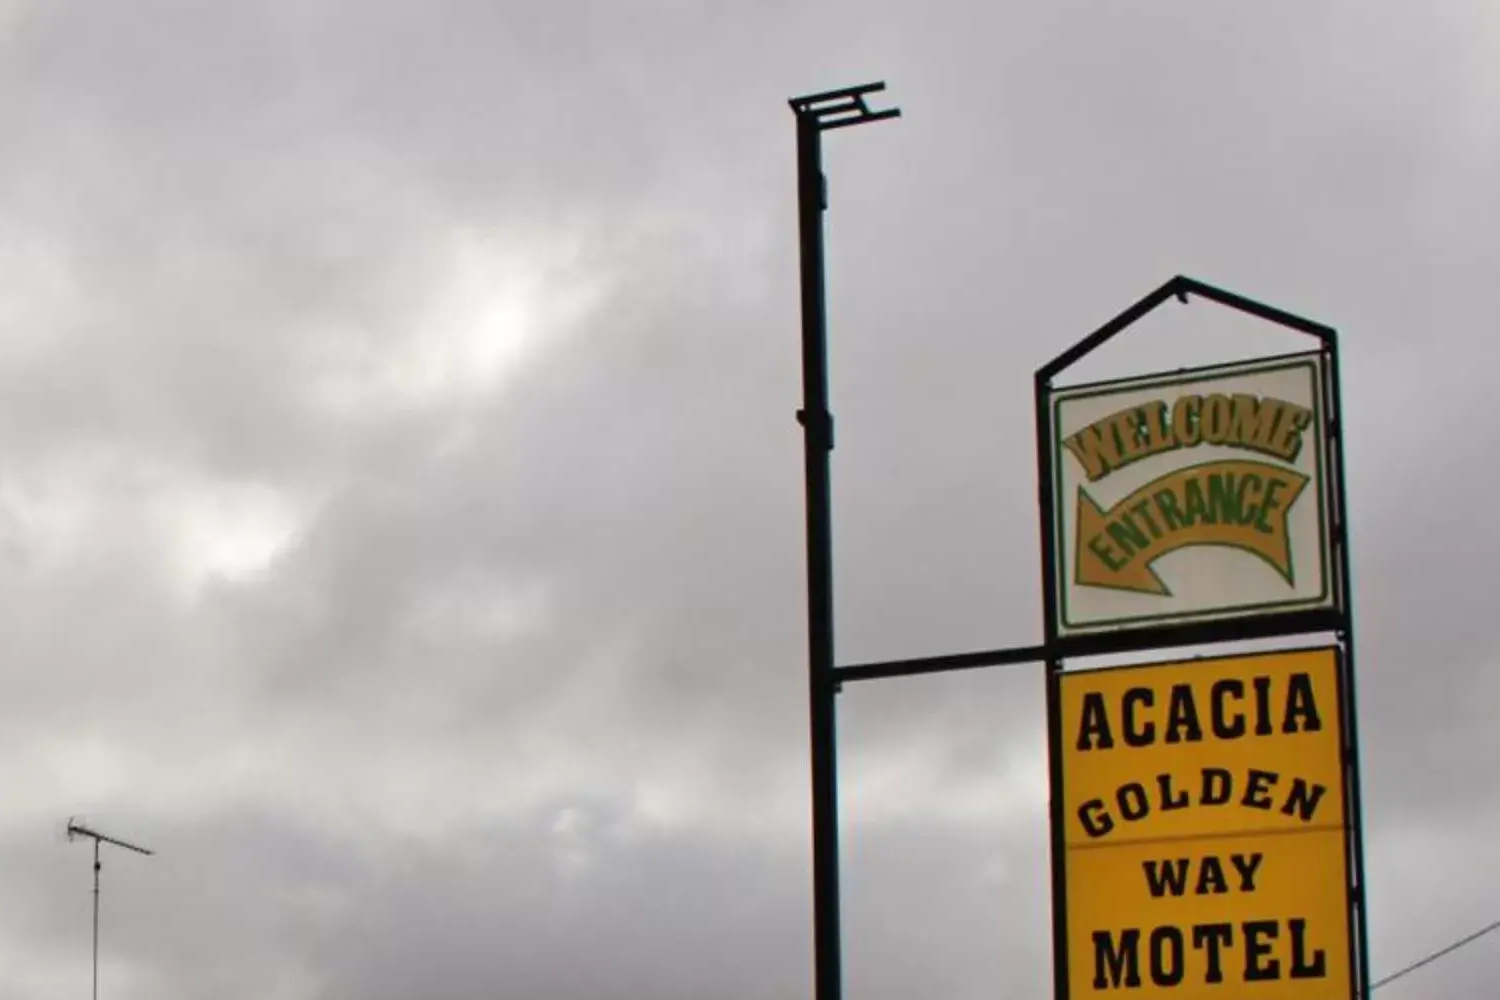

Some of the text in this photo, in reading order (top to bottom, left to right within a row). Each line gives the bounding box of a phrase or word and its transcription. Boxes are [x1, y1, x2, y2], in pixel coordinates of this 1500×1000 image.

[1062, 392, 1312, 482] WELCOME
[1088, 472, 1287, 572] ENTRANCE
[1076, 672, 1322, 751] ACACIA
[1077, 768, 1327, 838] GOLDEN
[1142, 853, 1263, 898] WAY
[1092, 918, 1326, 990] MOTEL
